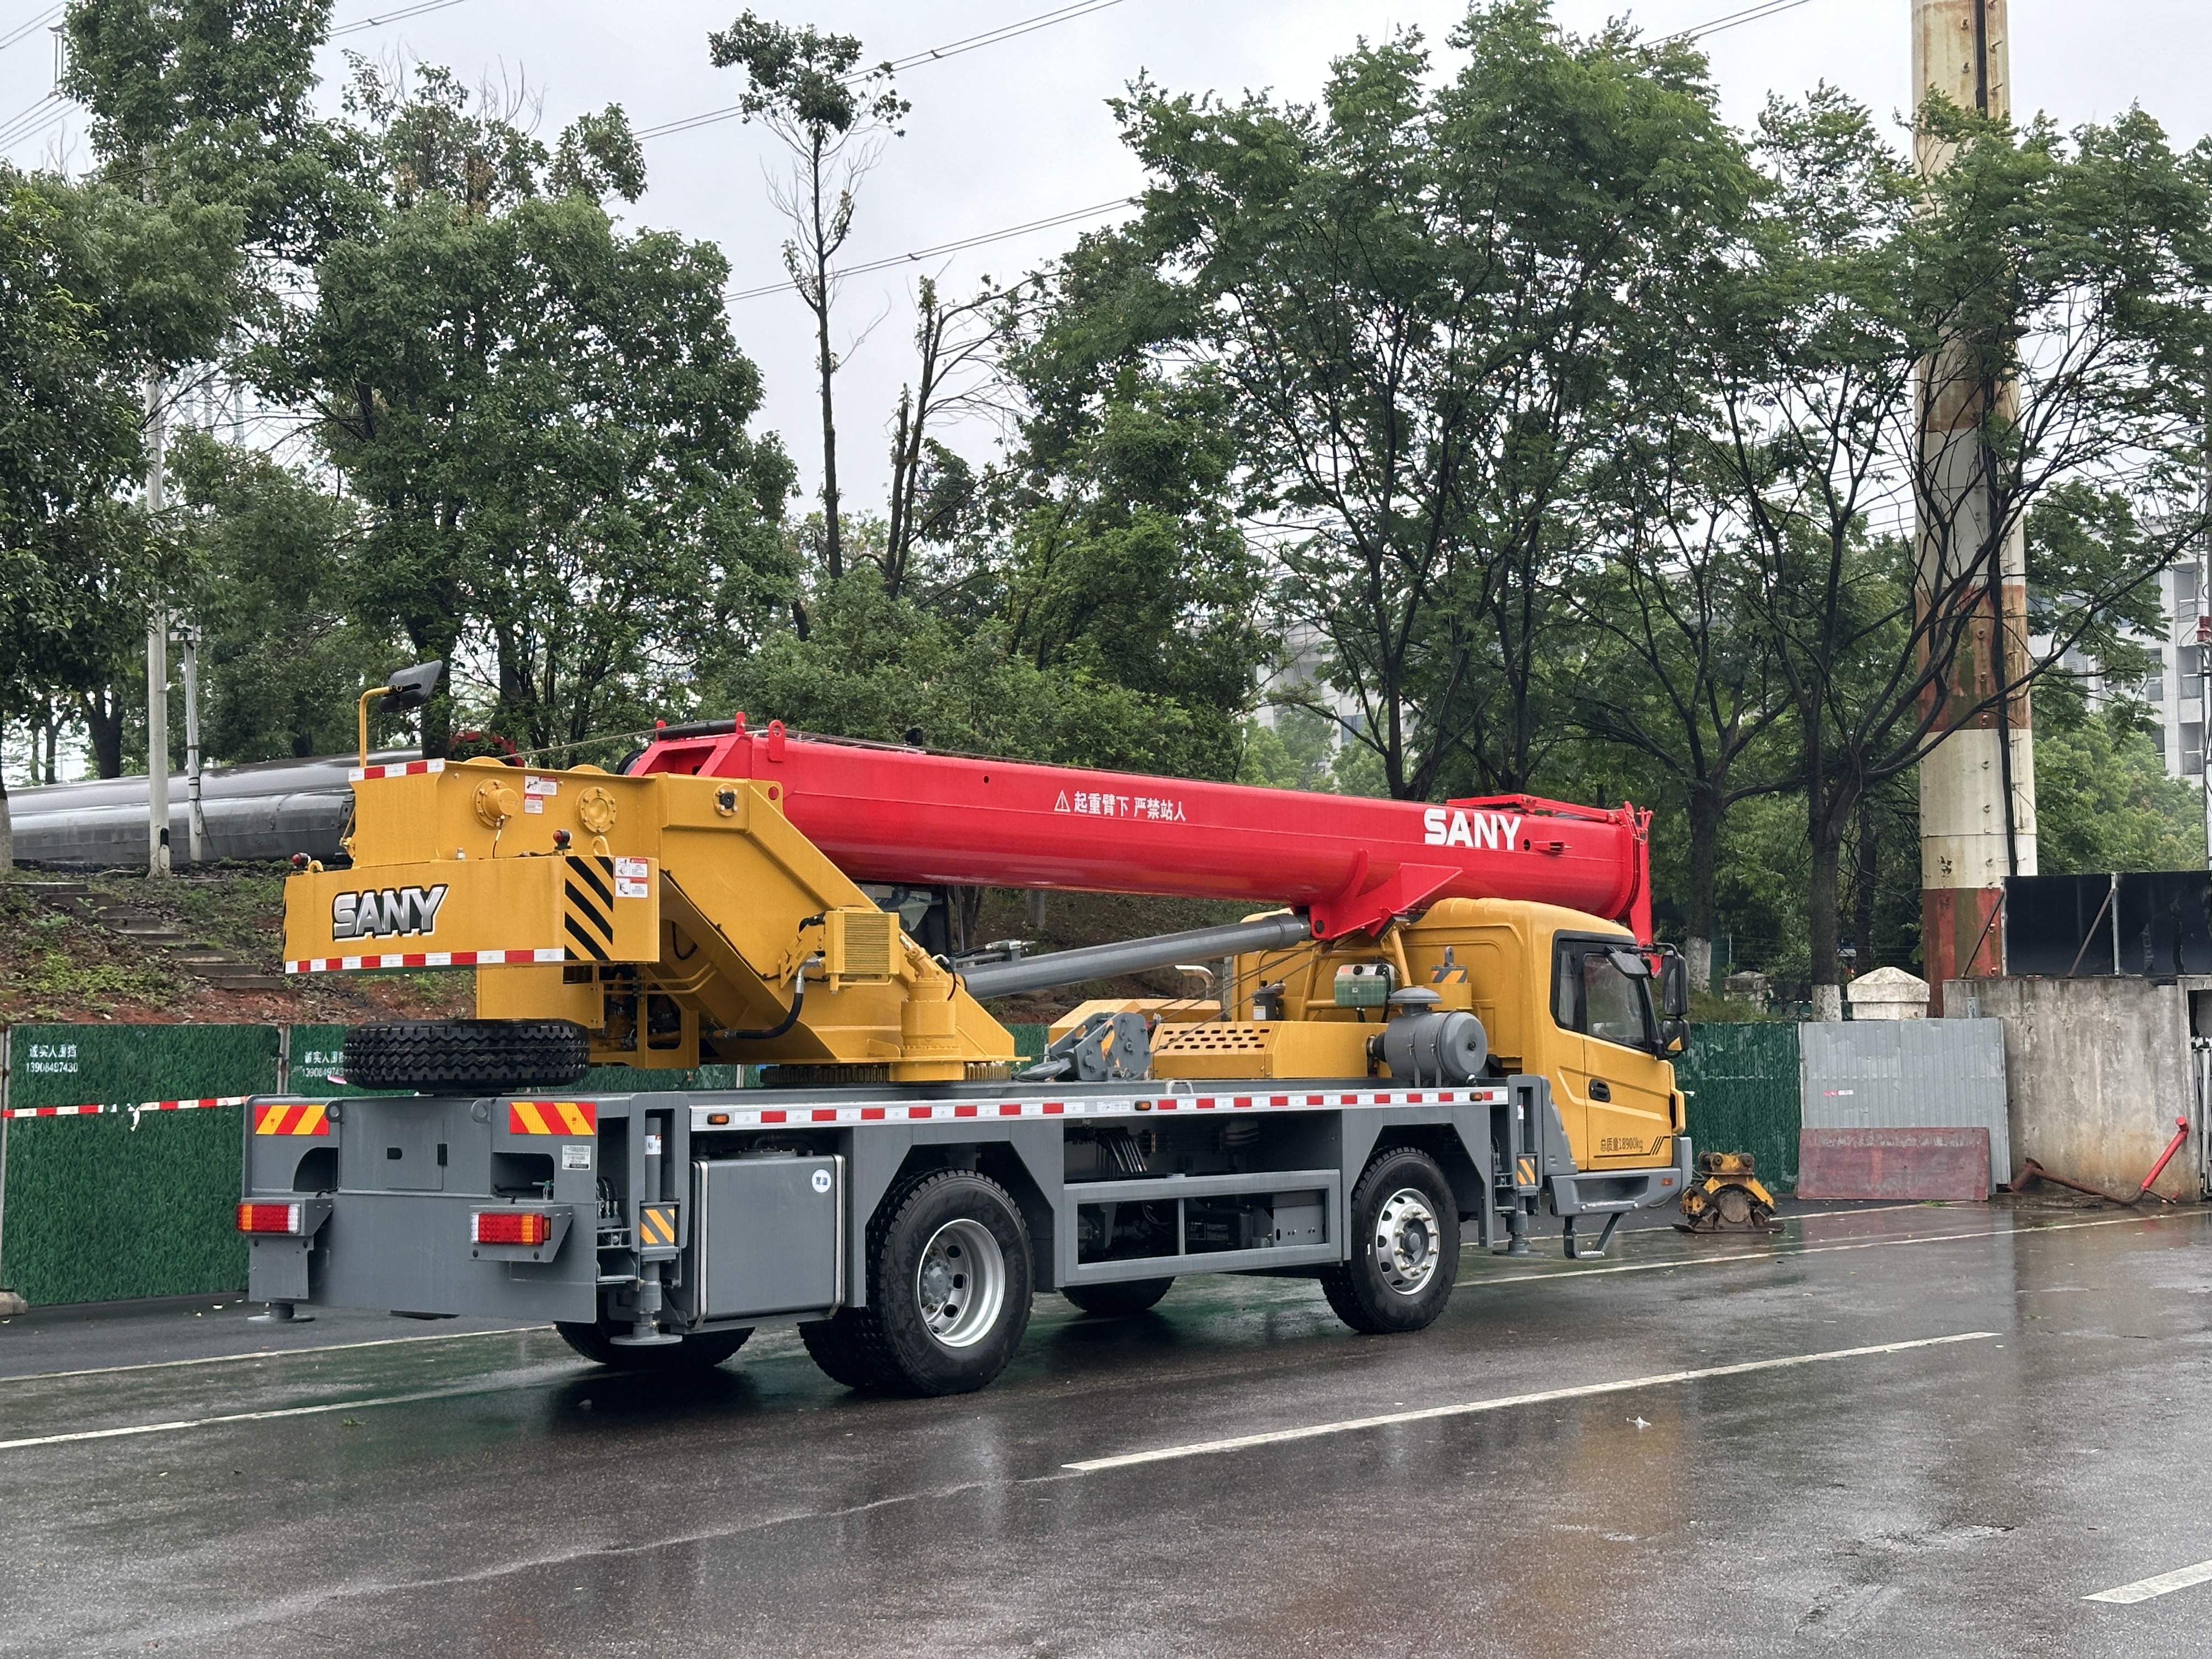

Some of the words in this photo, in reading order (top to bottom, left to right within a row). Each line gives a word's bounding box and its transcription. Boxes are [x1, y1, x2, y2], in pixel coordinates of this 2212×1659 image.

[1074, 791, 1129, 817] 起重臂下
[1133, 797, 1186, 822] 严禁站人
[1424, 808, 1521, 850] SANY
[331, 883, 449, 941] SANY
[26, 1062, 78, 1073] 13908497430
